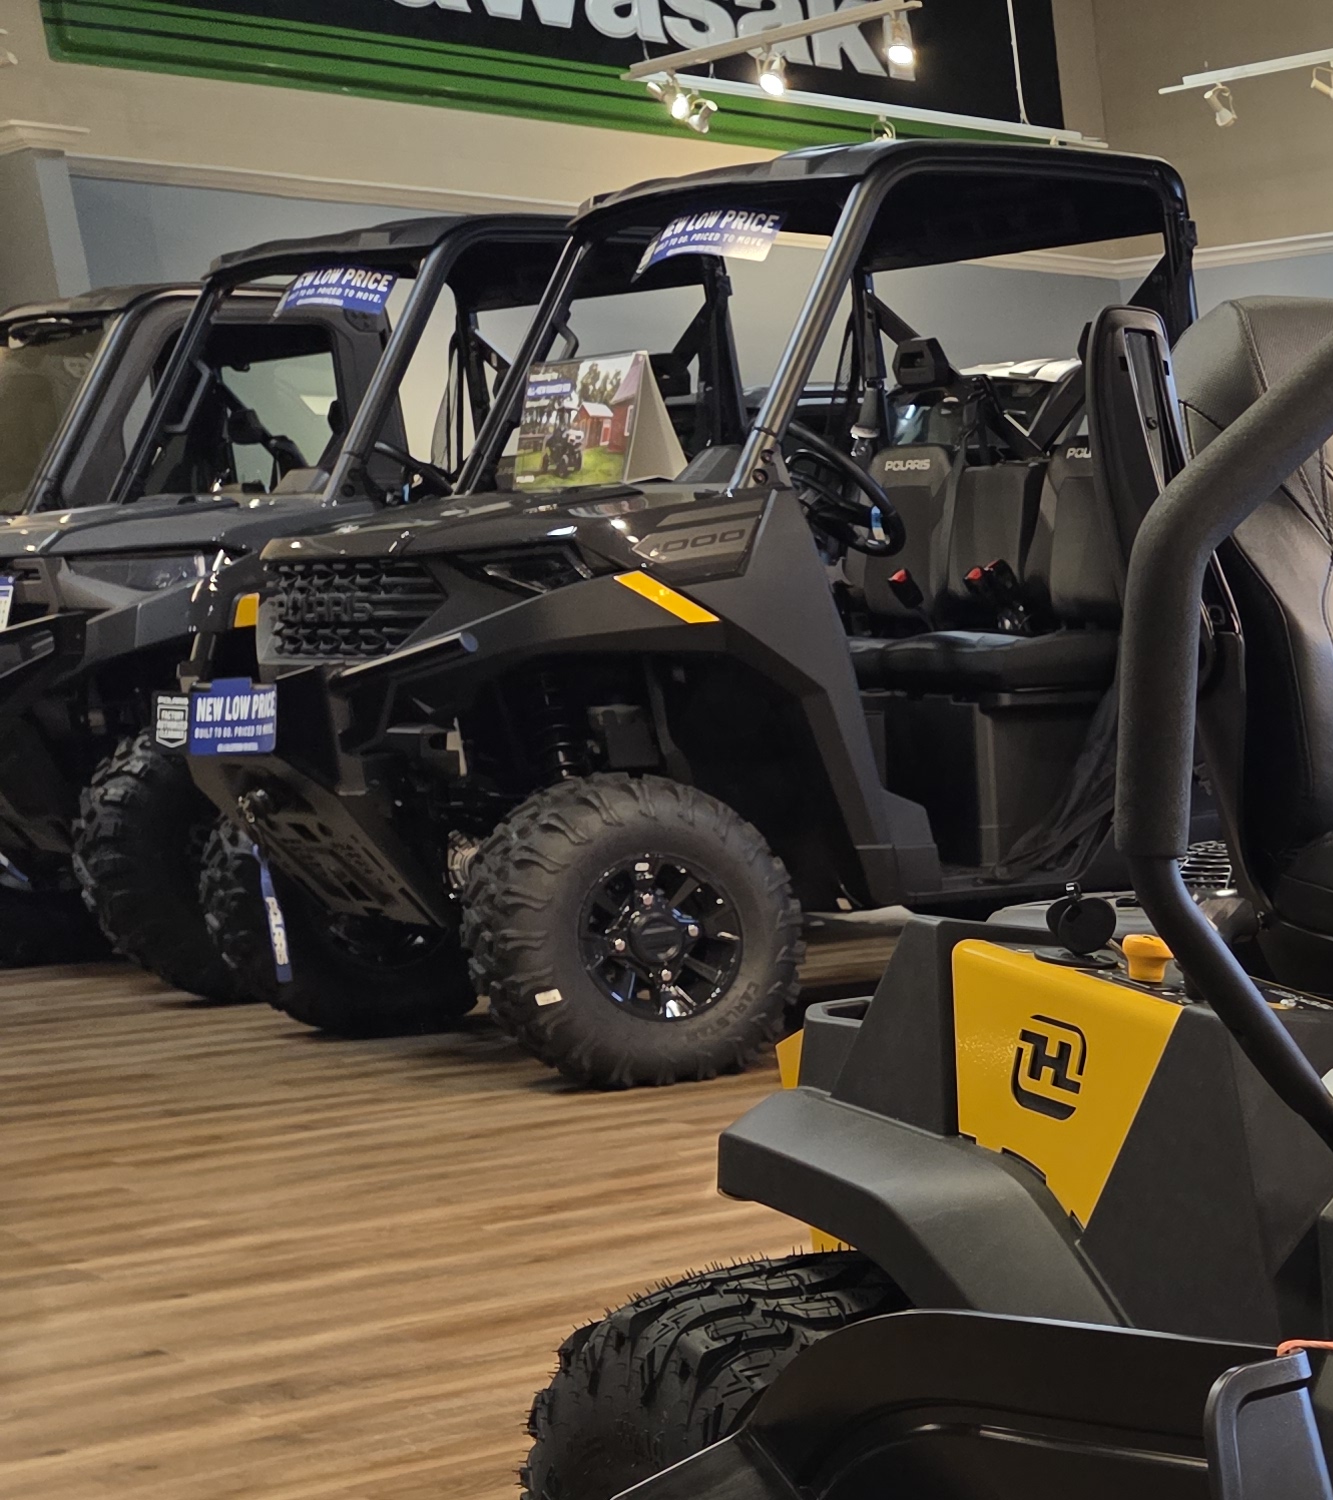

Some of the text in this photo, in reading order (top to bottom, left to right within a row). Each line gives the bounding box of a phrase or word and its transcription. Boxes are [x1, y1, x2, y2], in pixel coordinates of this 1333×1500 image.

[660, 210, 780, 242] EW LOW PRICE
[722, 233, 734, 243] TO
[313, 268, 344, 285] LOW
[341, 268, 392, 292] PRICE
[343, 288, 355, 297] TO
[885, 458, 931, 471] POLARIS
[196, 690, 275, 722] NEW LOW PRICE
